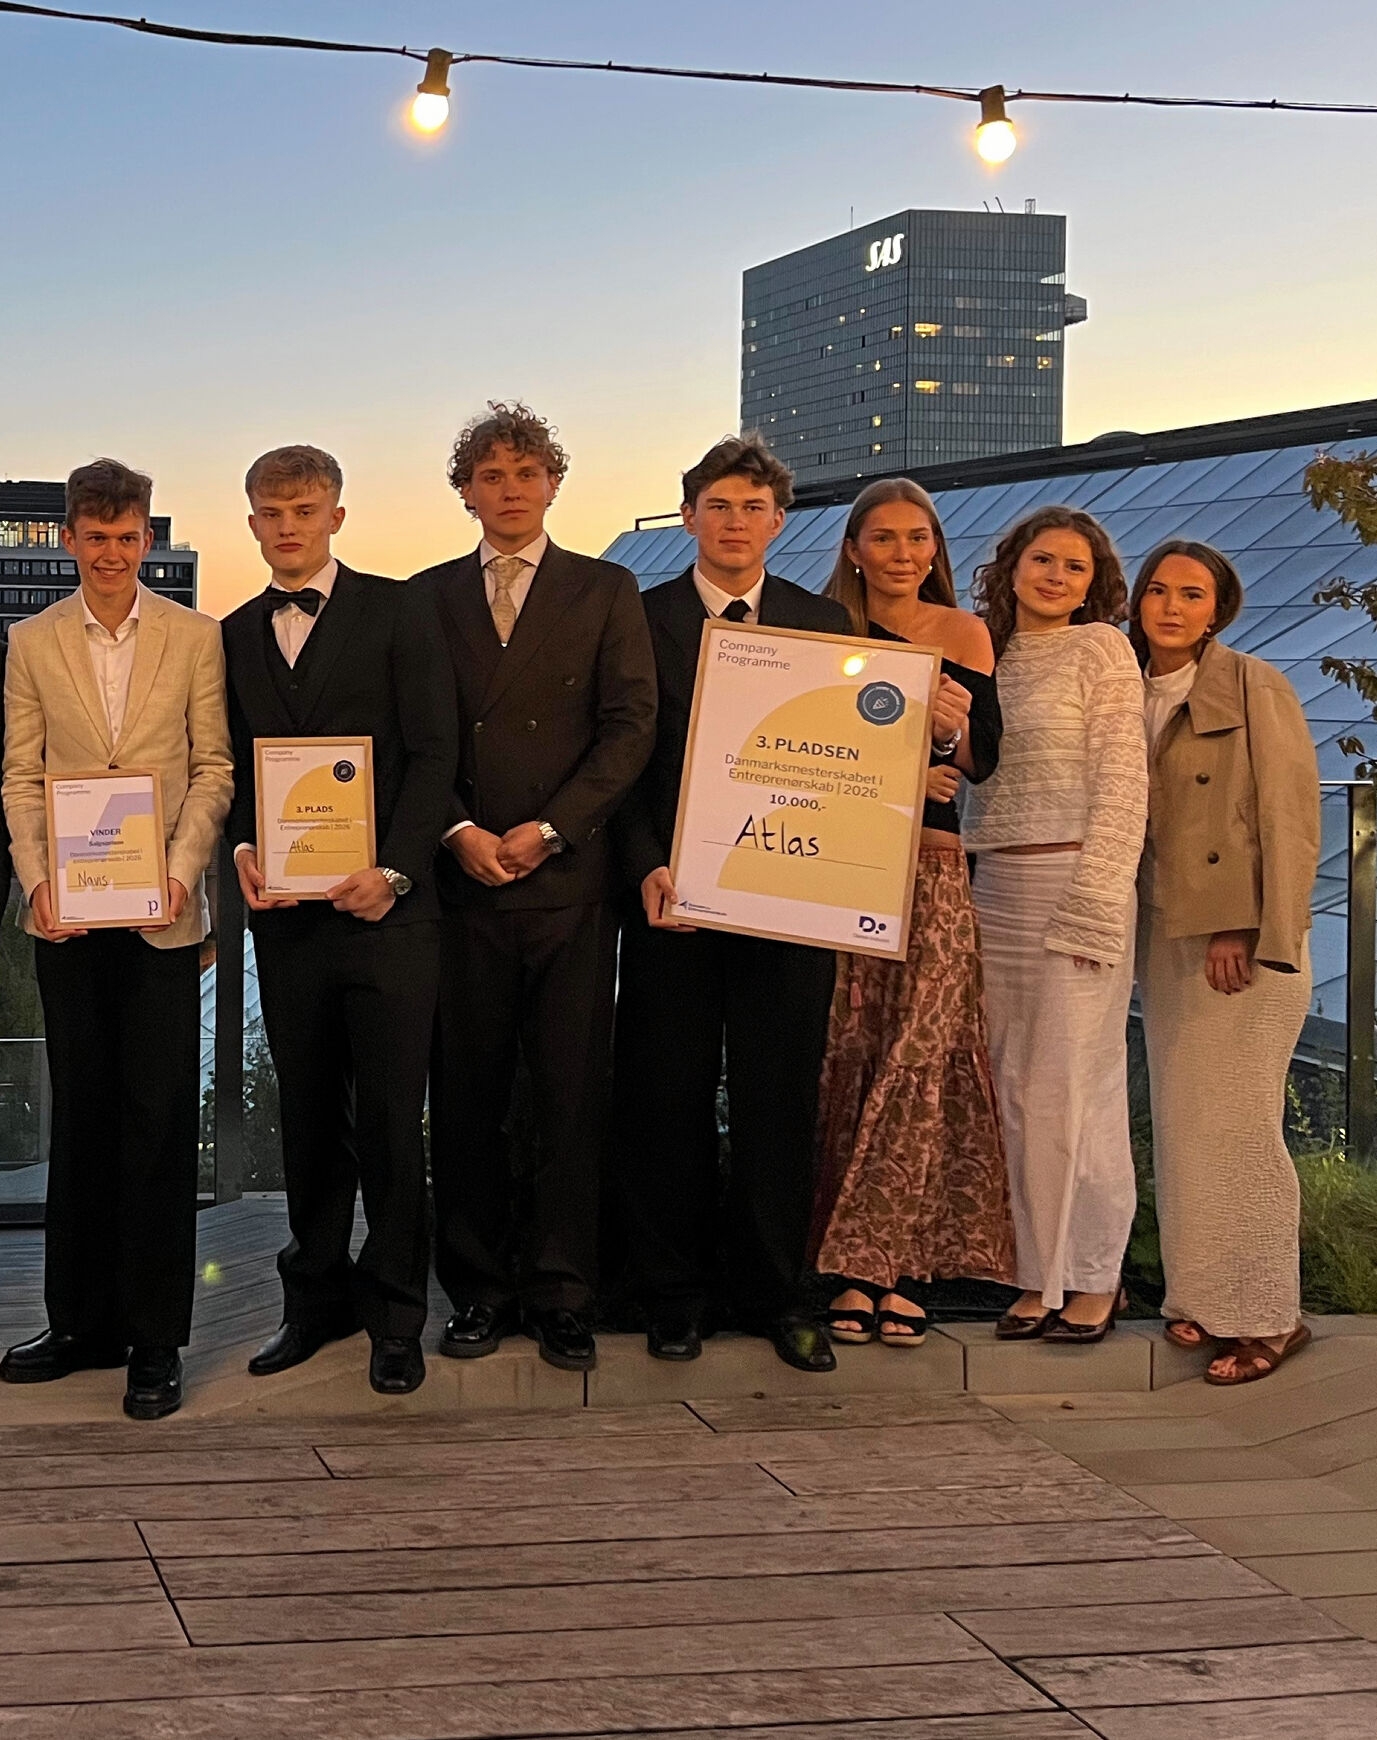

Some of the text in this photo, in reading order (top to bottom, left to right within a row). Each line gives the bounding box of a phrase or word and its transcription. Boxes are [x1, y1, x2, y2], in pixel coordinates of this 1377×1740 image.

[865, 233, 905, 272] SAS
[719, 639, 778, 656] Company
[718, 652, 790, 670] Programme
[756, 736, 860, 761] 3. PLADSEN
[725, 753, 878, 785] Danmarksmesterskabet
[728, 768, 834, 793] Entreprenørskab
[843, 784, 878, 798] 2026
[770, 794, 826, 812] 10.000,-
[90, 828, 121, 836] VINDER
[735, 814, 820, 857] Atlas
[289, 841, 315, 853] Atlas
